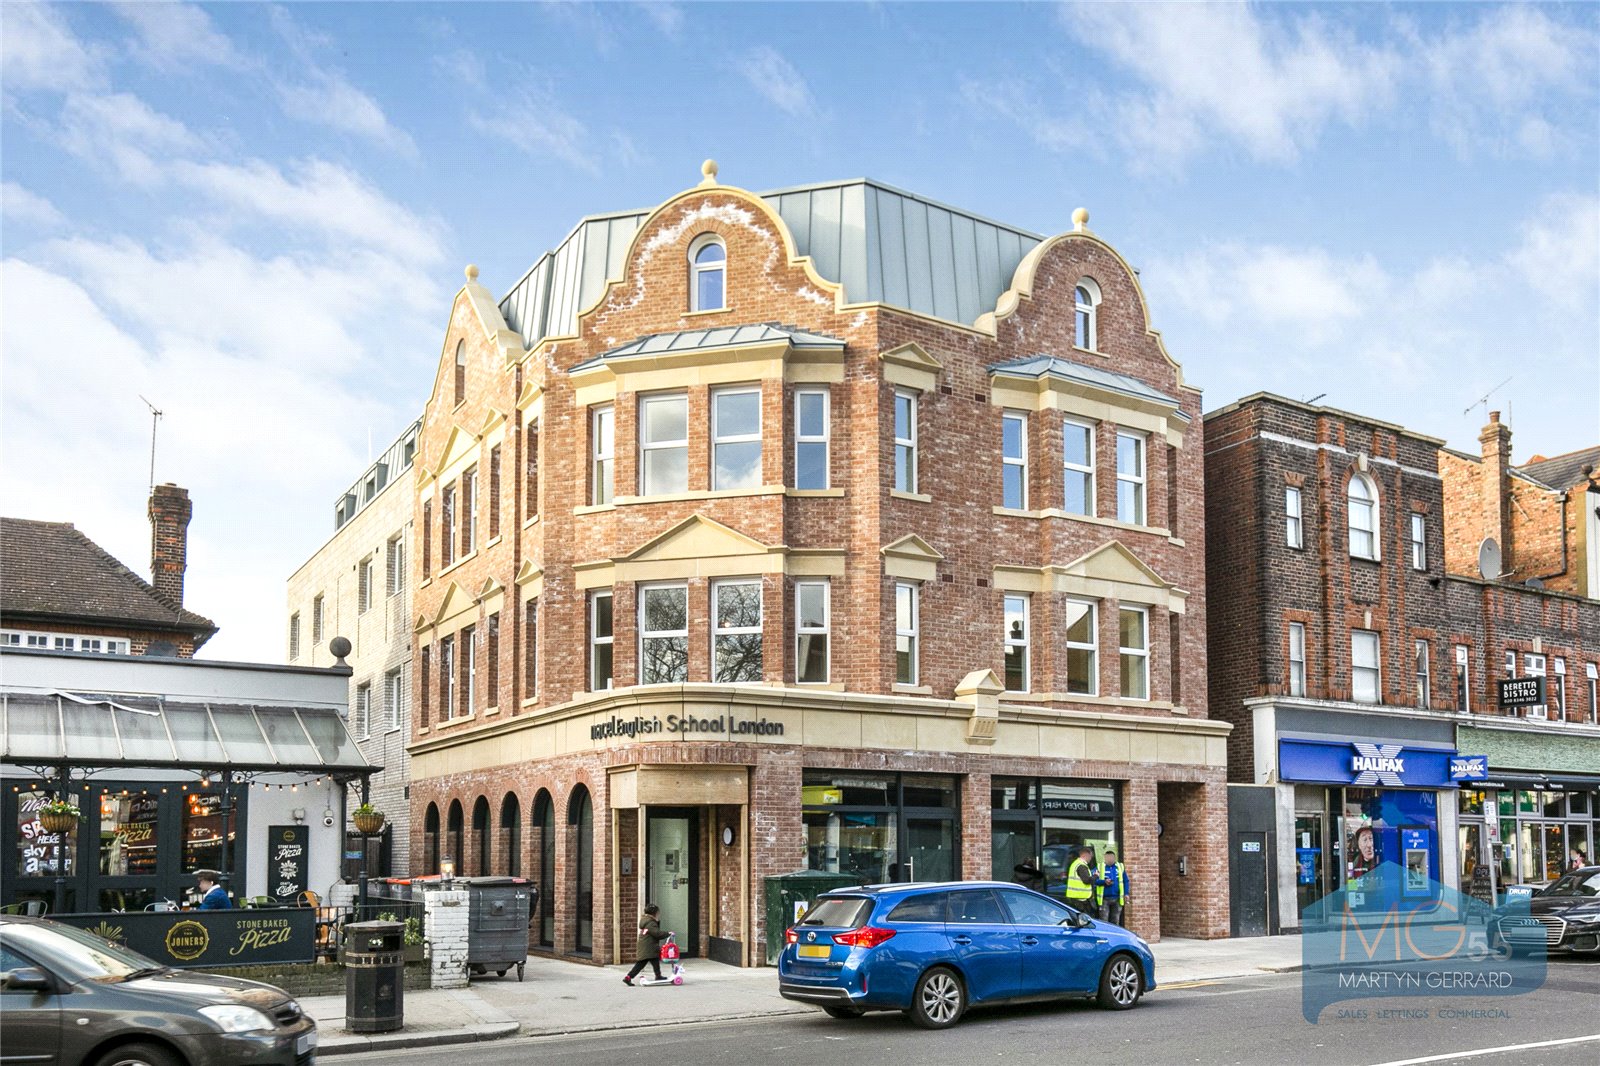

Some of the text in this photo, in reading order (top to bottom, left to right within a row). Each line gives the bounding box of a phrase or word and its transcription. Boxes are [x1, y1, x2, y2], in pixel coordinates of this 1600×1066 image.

[1503, 681, 1537, 691] BERETTA
[1503, 689, 1537, 698] BISTRO
[617, 716, 662, 738] English
[667, 714, 726, 733] School
[729, 716, 784, 736] London
[1353, 756, 1405, 772] HALIFAX
[1451, 763, 1485, 772] HALIFAX
[24, 844, 47, 857] sky
[274, 847, 303, 861] Pizza
[1508, 888, 1531, 896] DRURY
[237, 919, 288, 929] STONE BAKED
[171, 936, 204, 947] JOINERS
[229, 927, 292, 955] Pizza
